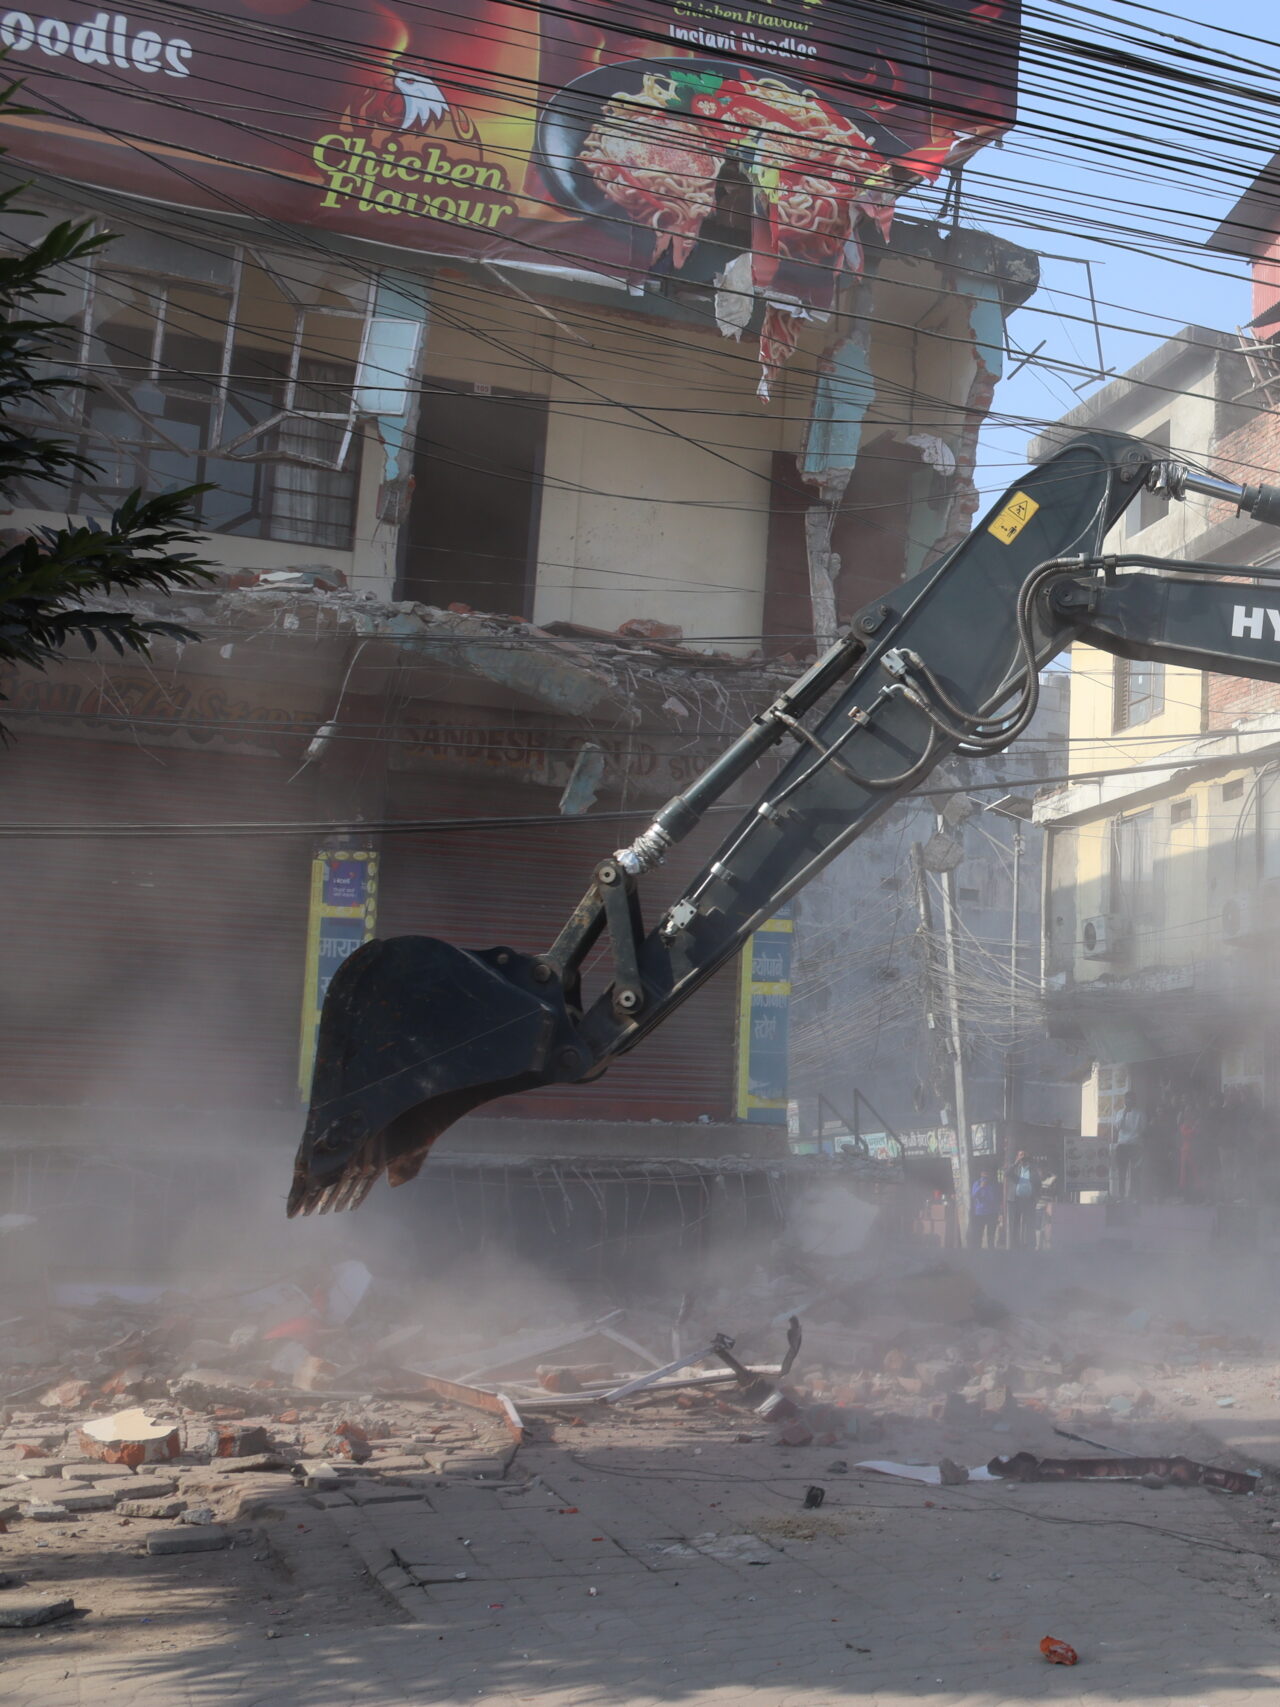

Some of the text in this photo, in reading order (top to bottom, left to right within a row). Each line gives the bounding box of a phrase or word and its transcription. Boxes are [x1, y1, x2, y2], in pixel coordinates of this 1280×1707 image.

[745, 11, 813, 31] Flavour
[312, 134, 505, 191] Chicken
[320, 171, 512, 228] Flavour
